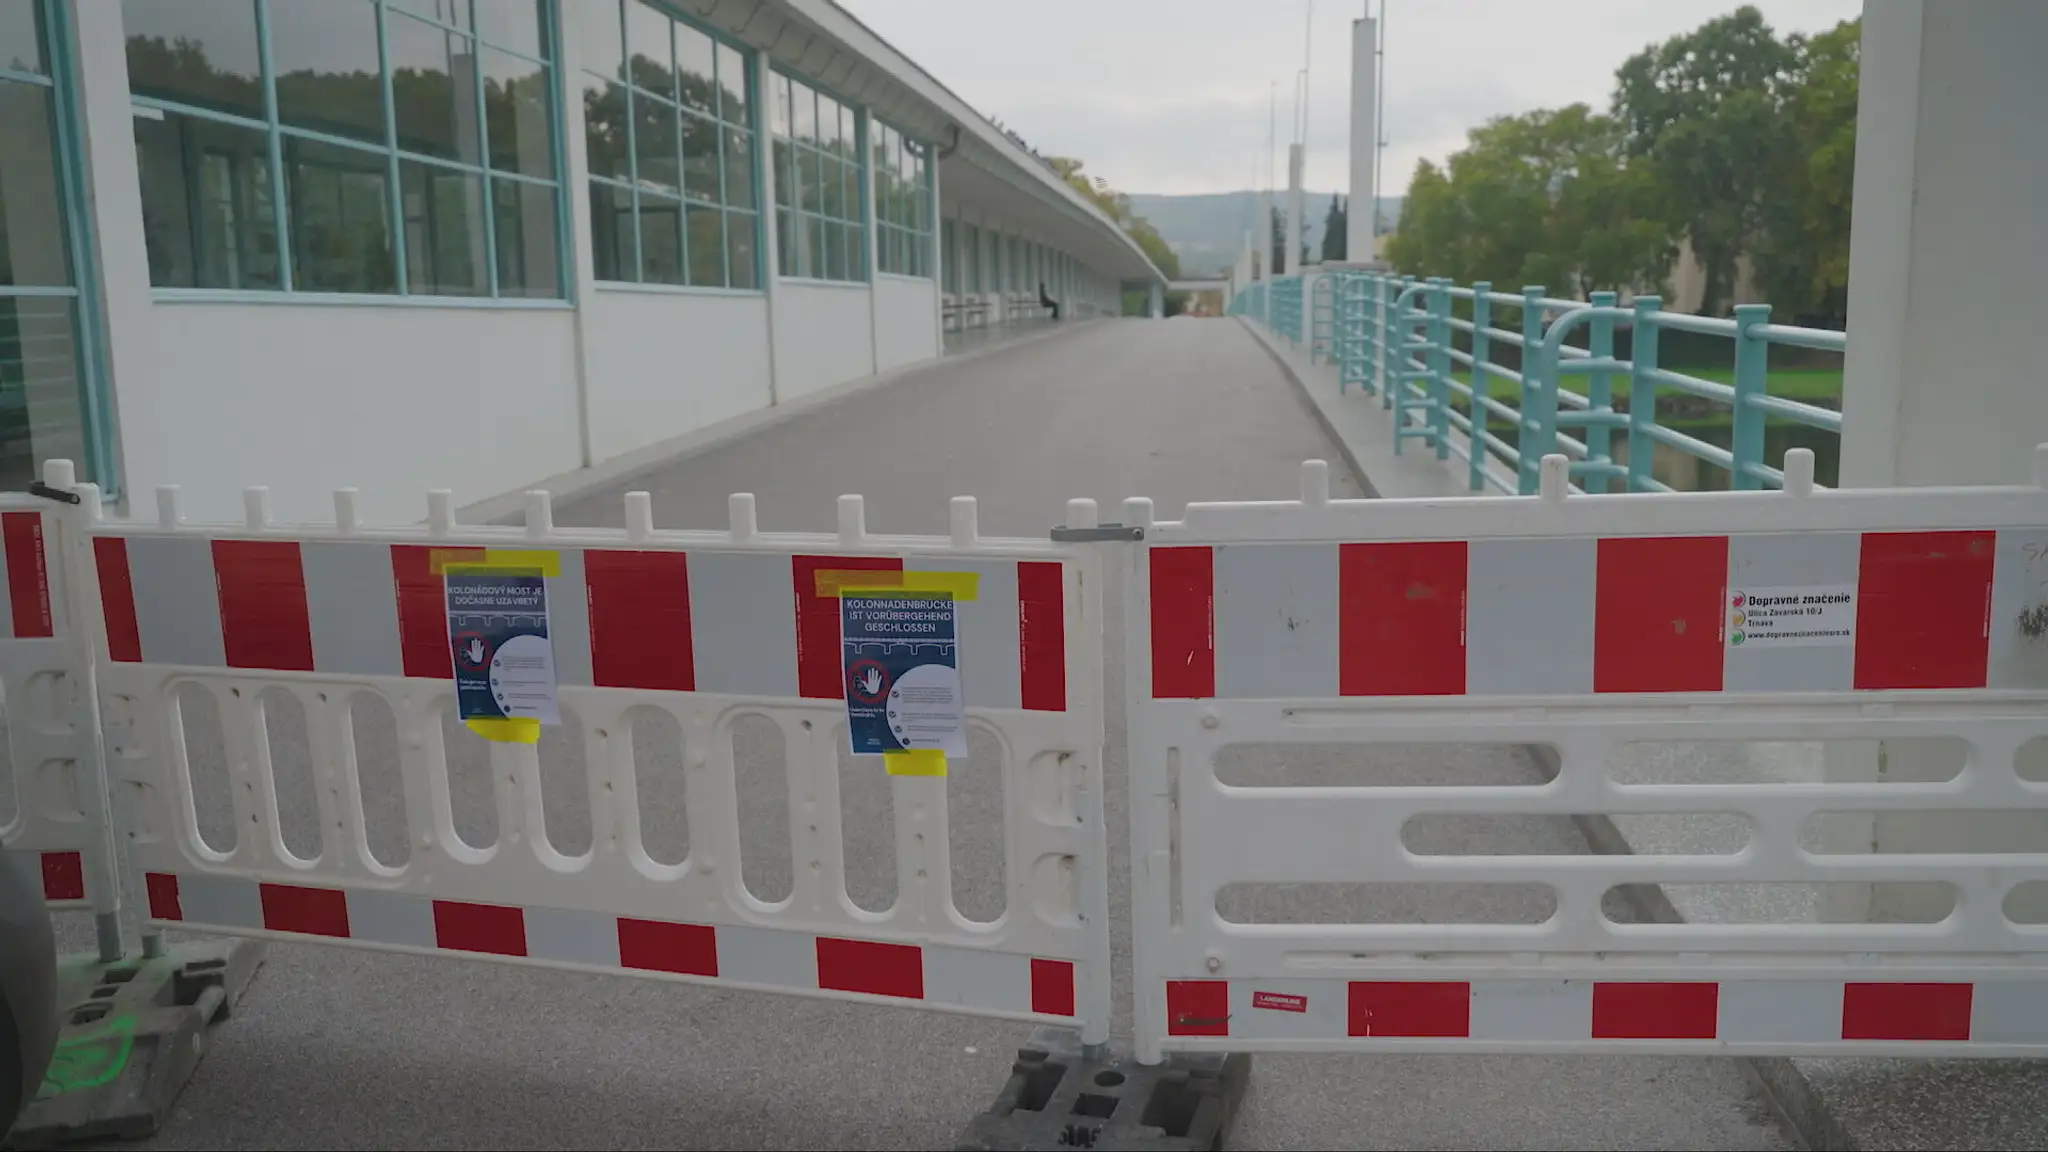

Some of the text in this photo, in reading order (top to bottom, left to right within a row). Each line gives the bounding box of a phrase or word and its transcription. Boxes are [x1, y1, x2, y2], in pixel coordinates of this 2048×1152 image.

[507, 586, 532, 596] MOST
[533, 586, 543, 596] JE
[846, 599, 953, 610] KOLONNADENBRÜCKE
[1749, 592, 1851, 607] Dopravné značenie
[849, 610, 951, 621] IST VORÜBERGEHEND
[864, 622, 936, 633] GESCHLOSSEN
[1748, 620, 1774, 628] Trnava
